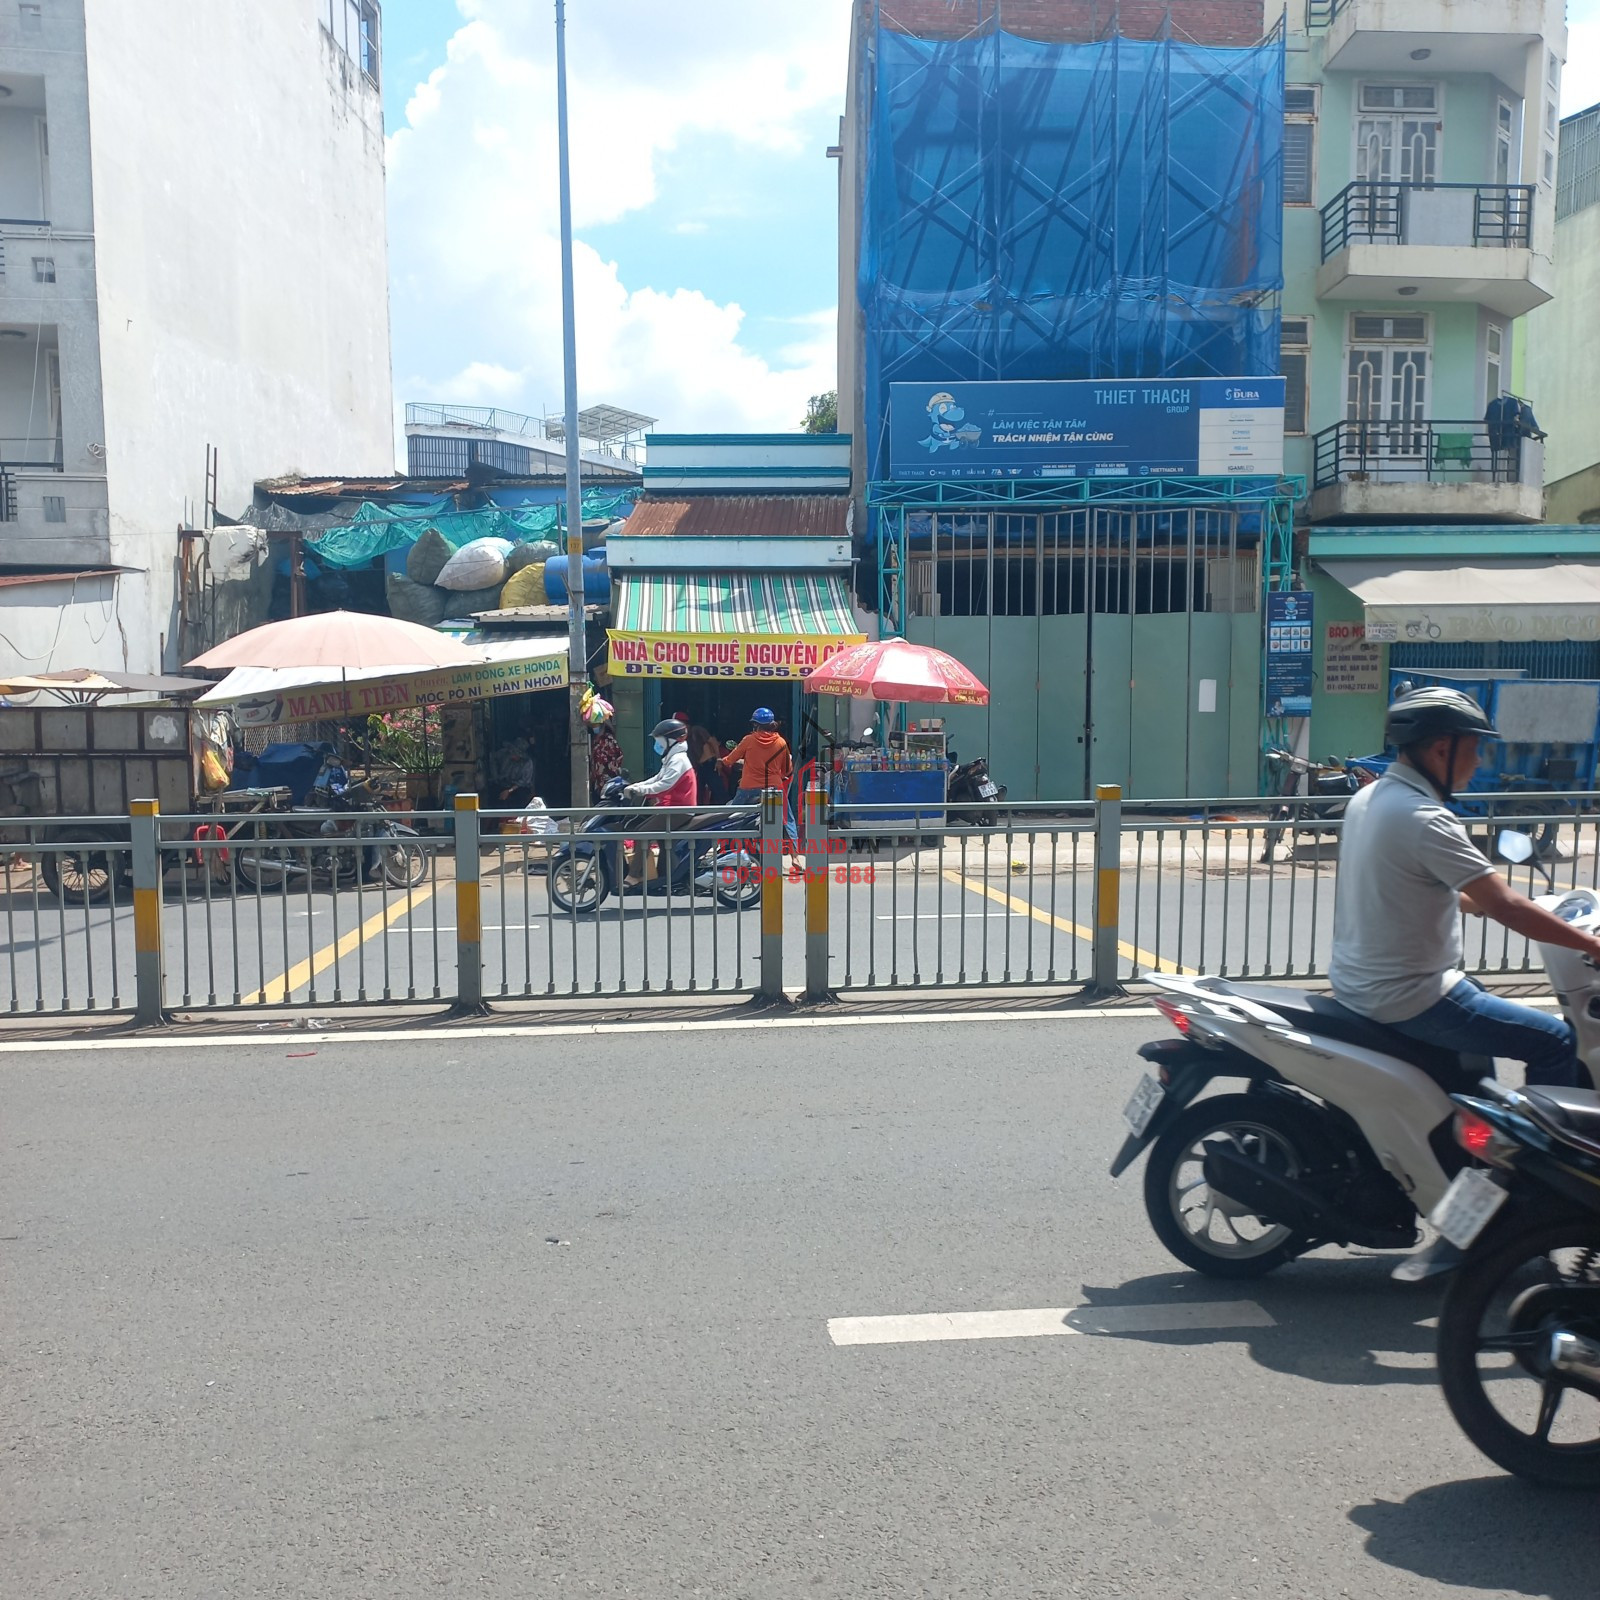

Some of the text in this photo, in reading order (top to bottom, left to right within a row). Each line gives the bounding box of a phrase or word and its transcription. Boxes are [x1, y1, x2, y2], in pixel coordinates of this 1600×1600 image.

[1094, 388, 1190, 404] THIET THACH
[1166, 405, 1190, 414] GROUP
[992, 419, 1014, 429] LÀM
[1017, 418, 1040, 431] VIỆC
[1064, 418, 1087, 429] TÂM
[992, 431, 1114, 444] TRÁCH NHIỆM TẬN CÙNG
[612, 637, 648, 662] NHÀ
[653, 641, 690, 663] CHO
[695, 640, 740, 664] THUÊ
[746, 640, 817, 665] NGUYÊN
[823, 640, 851, 663] CĂ
[507, 665, 521, 676] XE
[524, 659, 560, 674] HONDA
[625, 663, 817, 677] ĐT: 0903.955.9
[492, 679, 520, 694] HÀN
[524, 673, 562, 689] NHÔM
[287, 690, 353, 719] MẠNH
